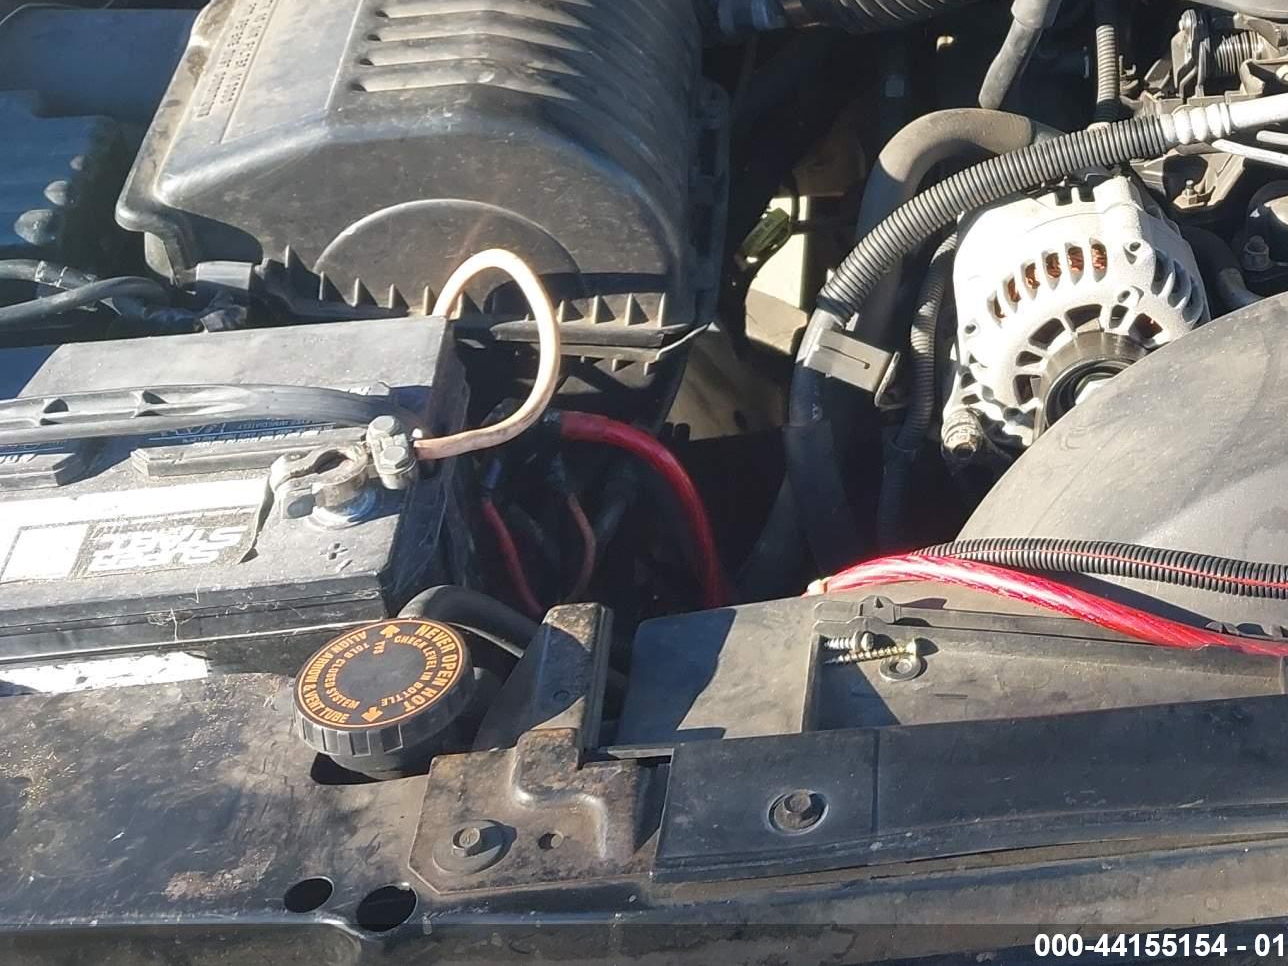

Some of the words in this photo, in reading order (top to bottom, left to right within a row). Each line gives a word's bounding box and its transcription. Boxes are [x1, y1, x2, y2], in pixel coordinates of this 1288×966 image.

[332, 631, 367, 654] ALIGN
[394, 635, 429, 649] CHECK
[414, 625, 456, 653] NEVER
[305, 653, 333, 683] ARROW
[422, 643, 437, 669] LEVEL
[324, 659, 346, 686] CLOSED
[420, 671, 433, 681] IN
[432, 654, 458, 686] OPEN
[304, 689, 325, 716] VENT
[326, 688, 360, 709] SYSTEM
[382, 682, 424, 706] BOTTLE
[402, 687, 438, 712] HOT
[321, 710, 349, 723] TUBE
